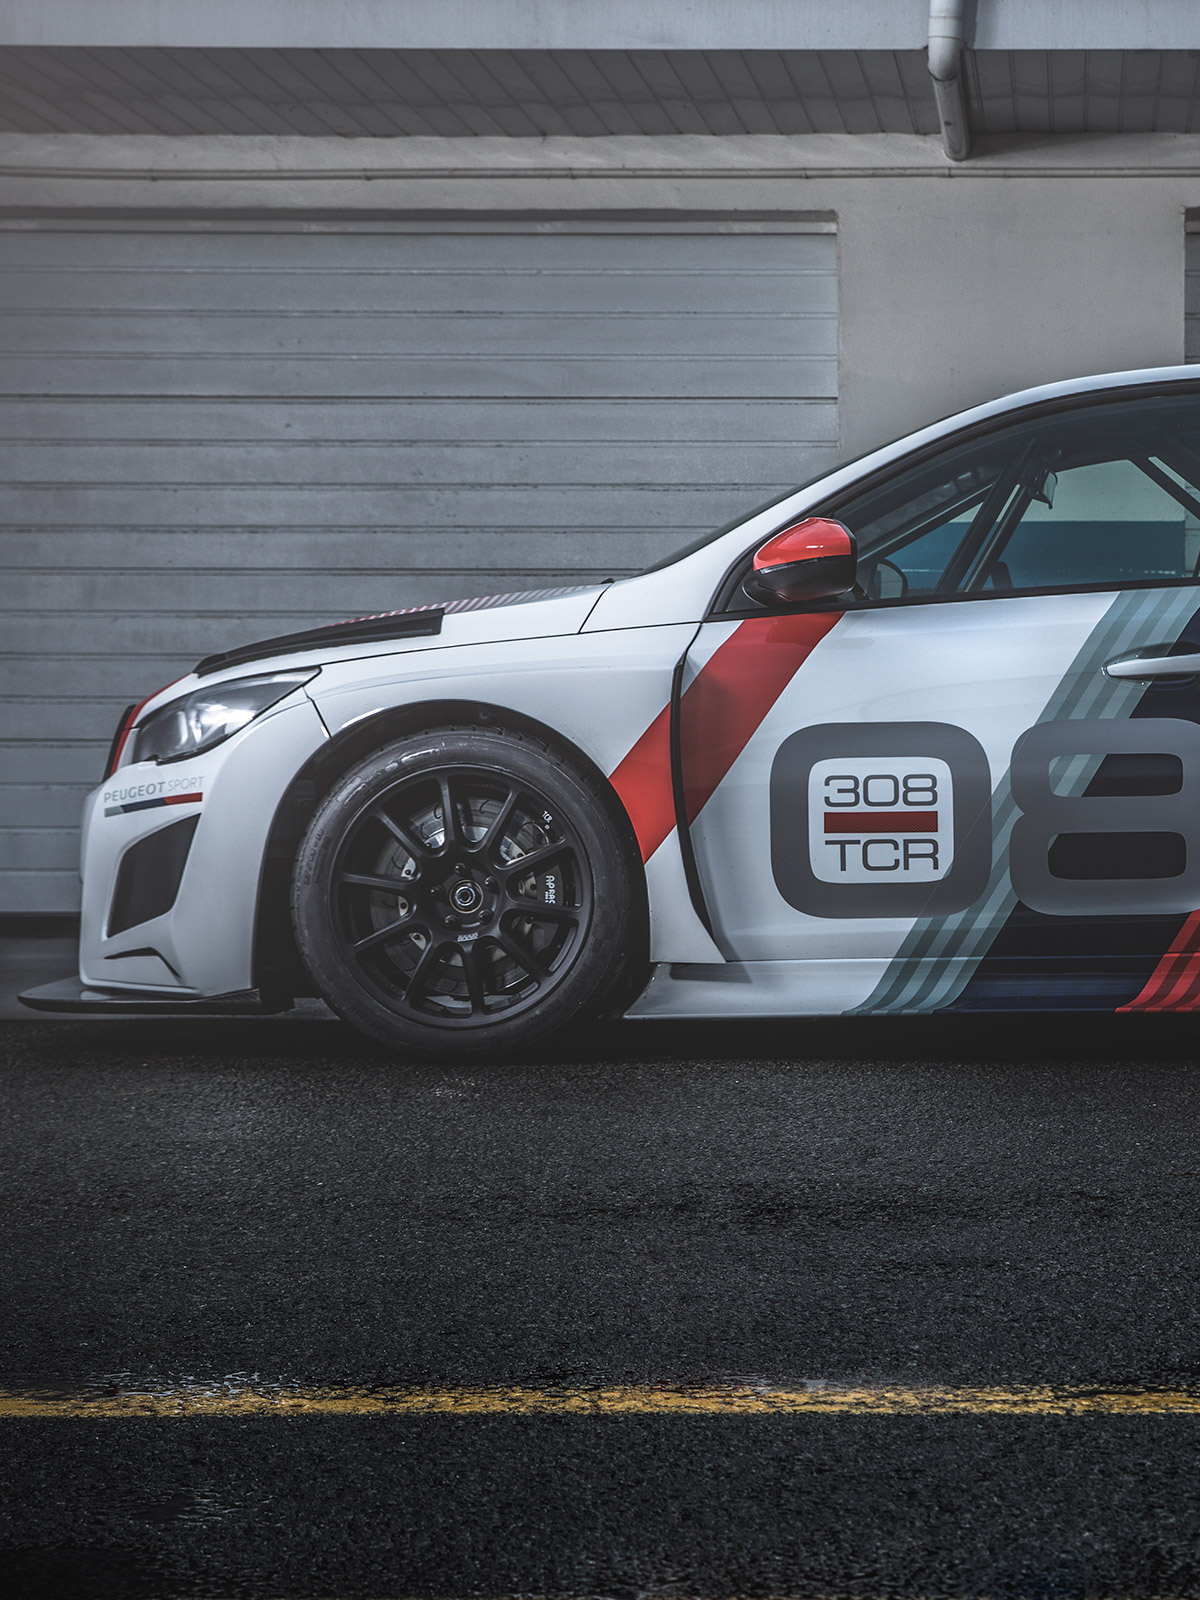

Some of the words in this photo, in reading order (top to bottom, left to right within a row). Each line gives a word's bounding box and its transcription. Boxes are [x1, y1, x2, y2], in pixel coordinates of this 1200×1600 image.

[103, 781, 166, 804] PEUGEOT
[167, 775, 205, 792] SPORT
[824, 773, 939, 808] 308
[824, 838, 939, 872] TCR
